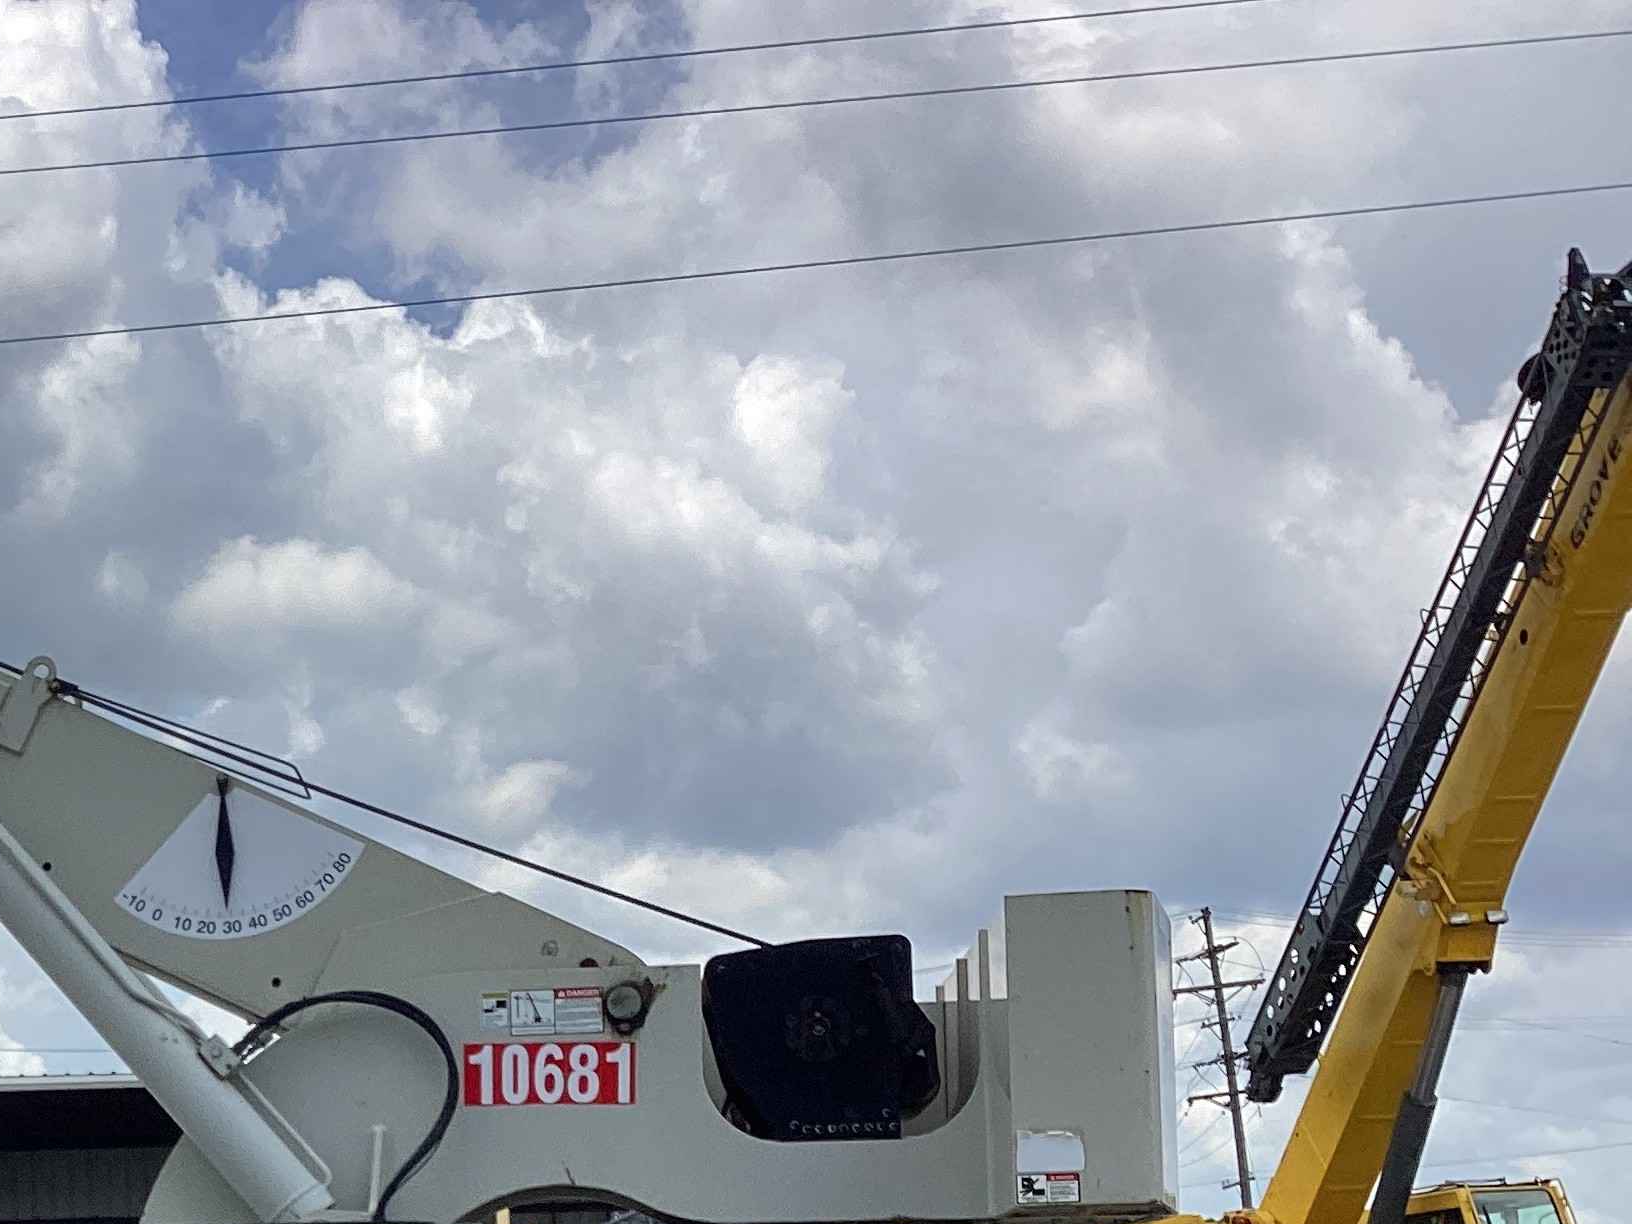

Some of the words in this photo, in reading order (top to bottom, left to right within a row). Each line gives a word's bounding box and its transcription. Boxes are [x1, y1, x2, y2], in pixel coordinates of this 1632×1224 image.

[151, 908, 164, 922] 0
[173, 916, 192, 932] 10
[196, 920, 217, 935] 20
[222, 919, 243, 935] 30
[248, 914, 268, 930] 40
[272, 903, 294, 923] 50
[295, 889, 316, 910] 60
[314, 872, 336, 893] 70
[332, 851, 353, 874] 80
[469, 1042, 631, 1105] 10681
